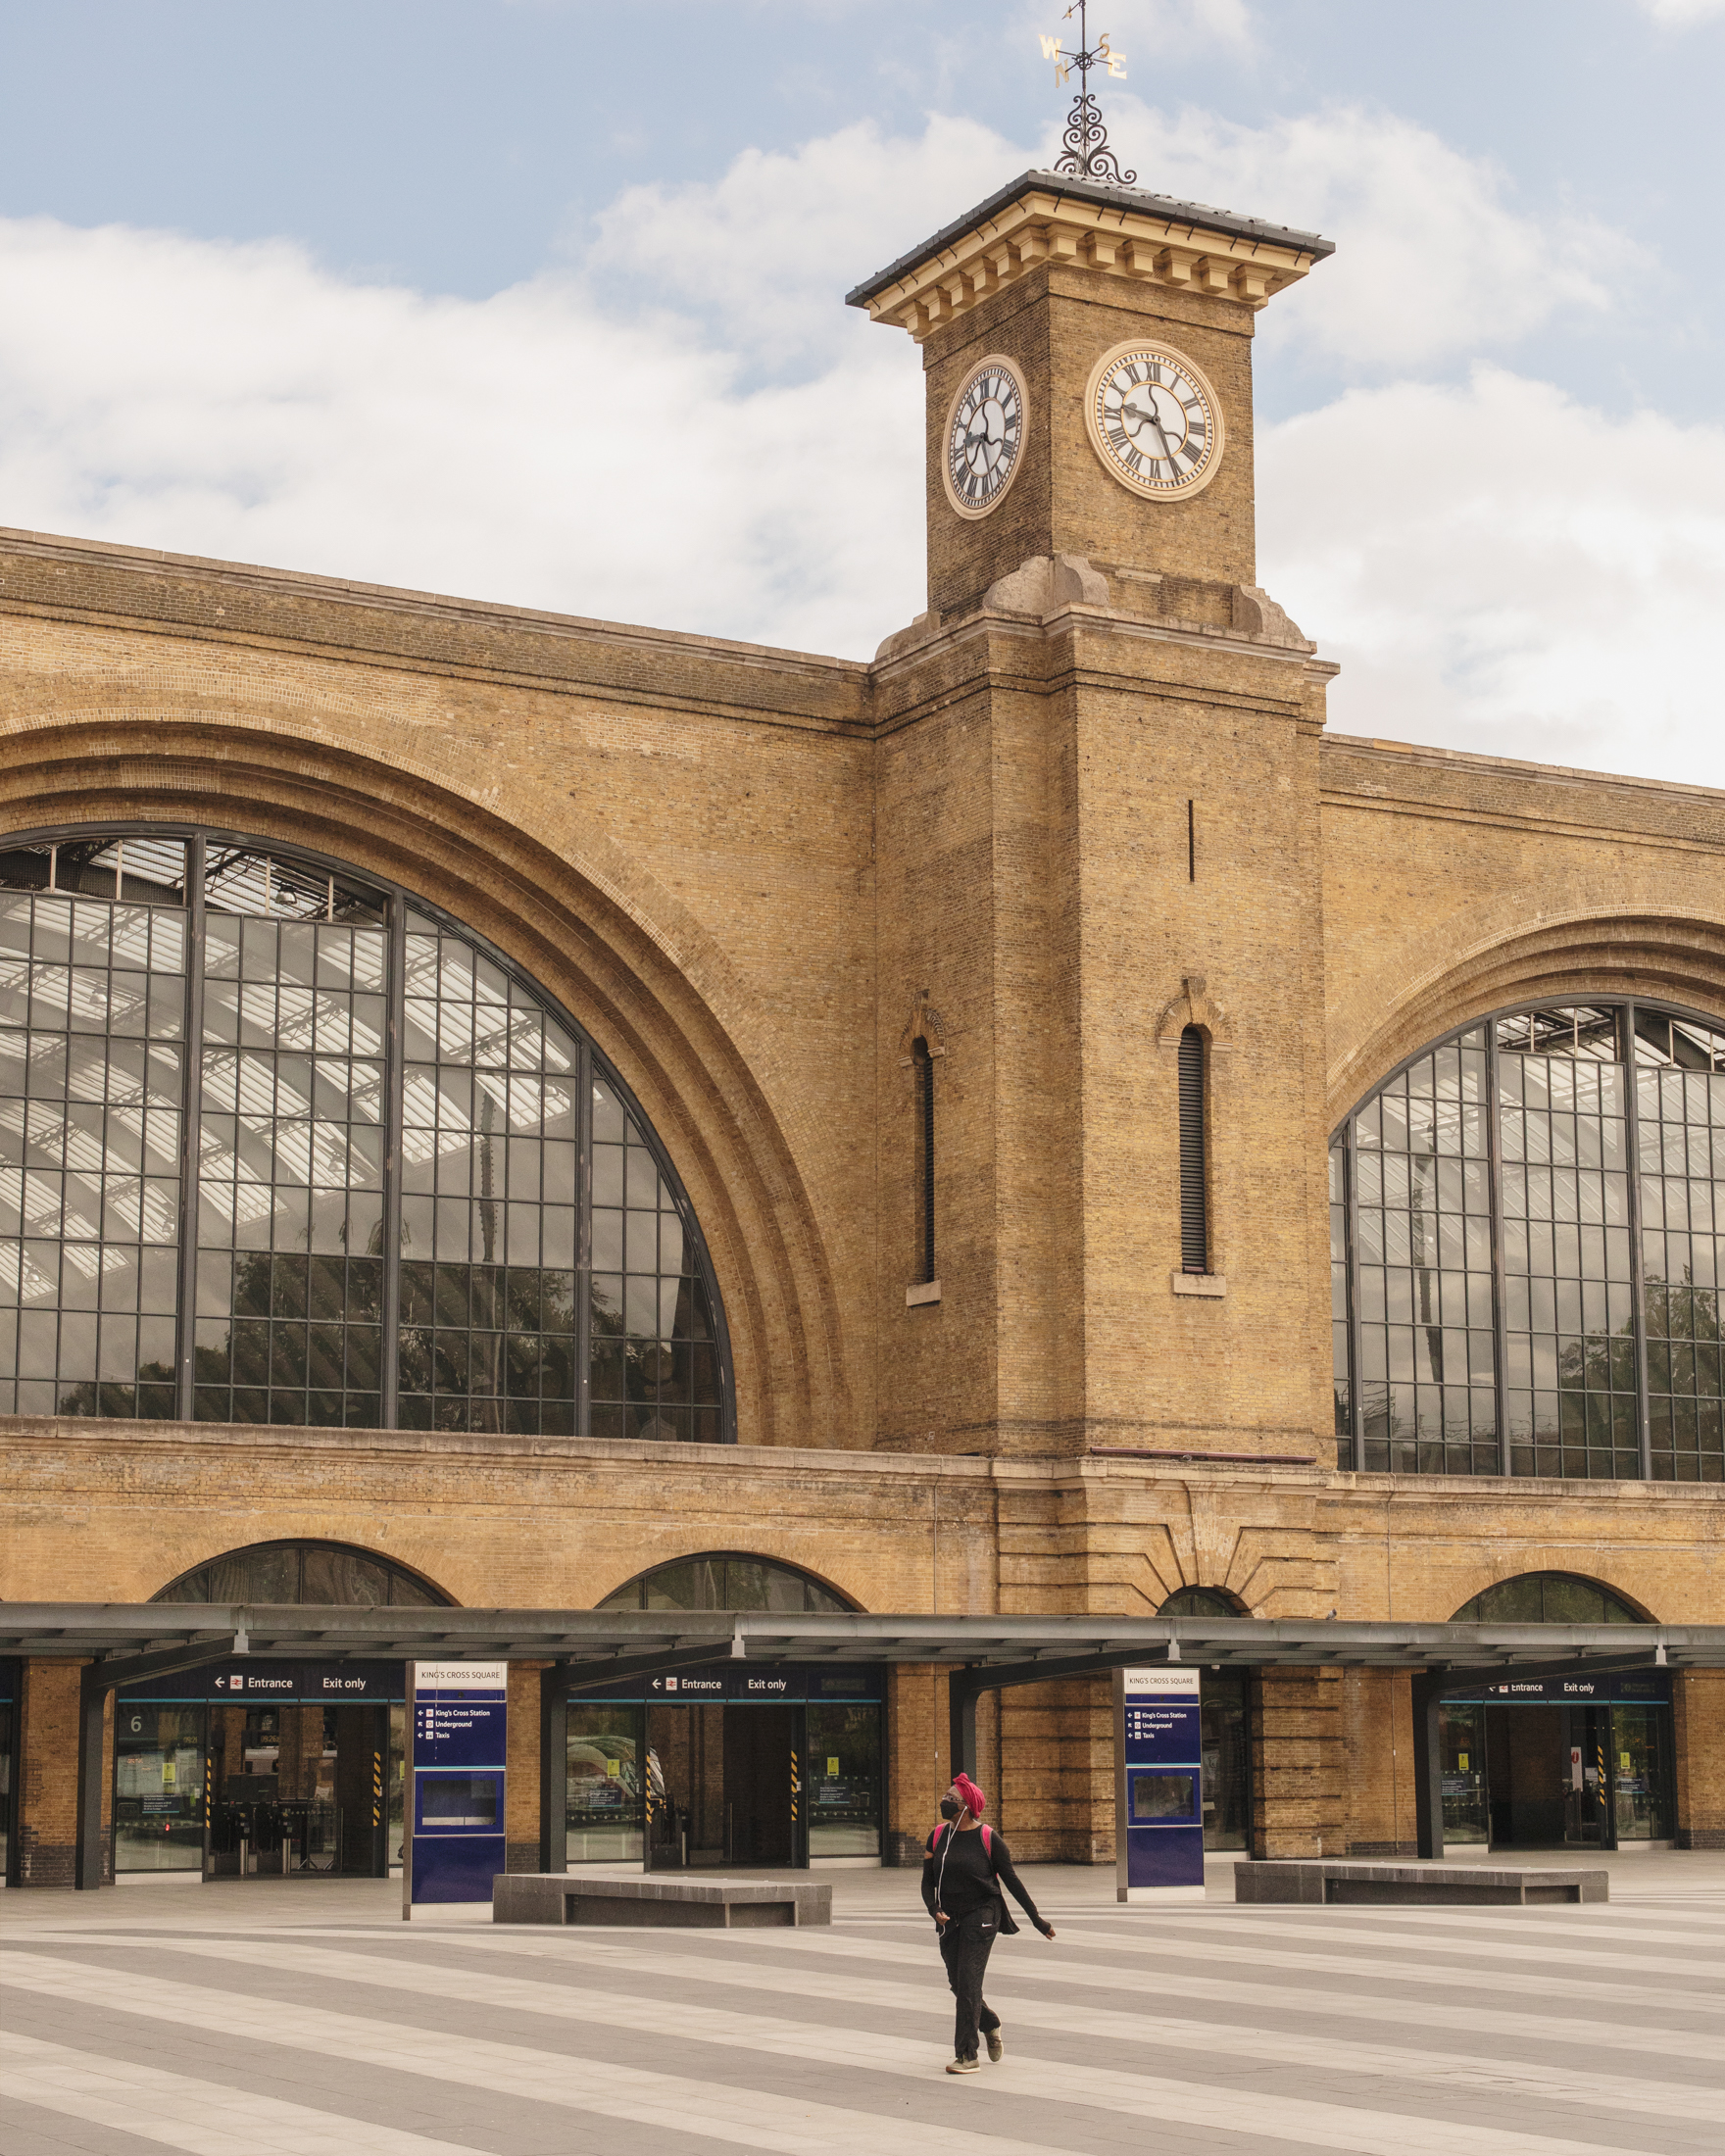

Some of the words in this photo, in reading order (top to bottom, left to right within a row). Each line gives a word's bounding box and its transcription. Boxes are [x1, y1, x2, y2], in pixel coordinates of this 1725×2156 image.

[1039, 34, 1062, 62] W
[1099, 33, 1109, 58] S
[1108, 52, 1127, 79] E
[1055, 59, 1069, 88] N
[248, 1678, 293, 1689] Entrance
[322, 1678, 343, 1689] Exit
[345, 1678, 367, 1690] only
[681, 1679, 722, 1690] Entrance
[748, 1679, 765, 1690] Exit
[767, 1679, 787, 1691] only
[1563, 1683, 1578, 1691] Exit
[1579, 1683, 1595, 1693] only
[130, 1715, 142, 1733] 6
